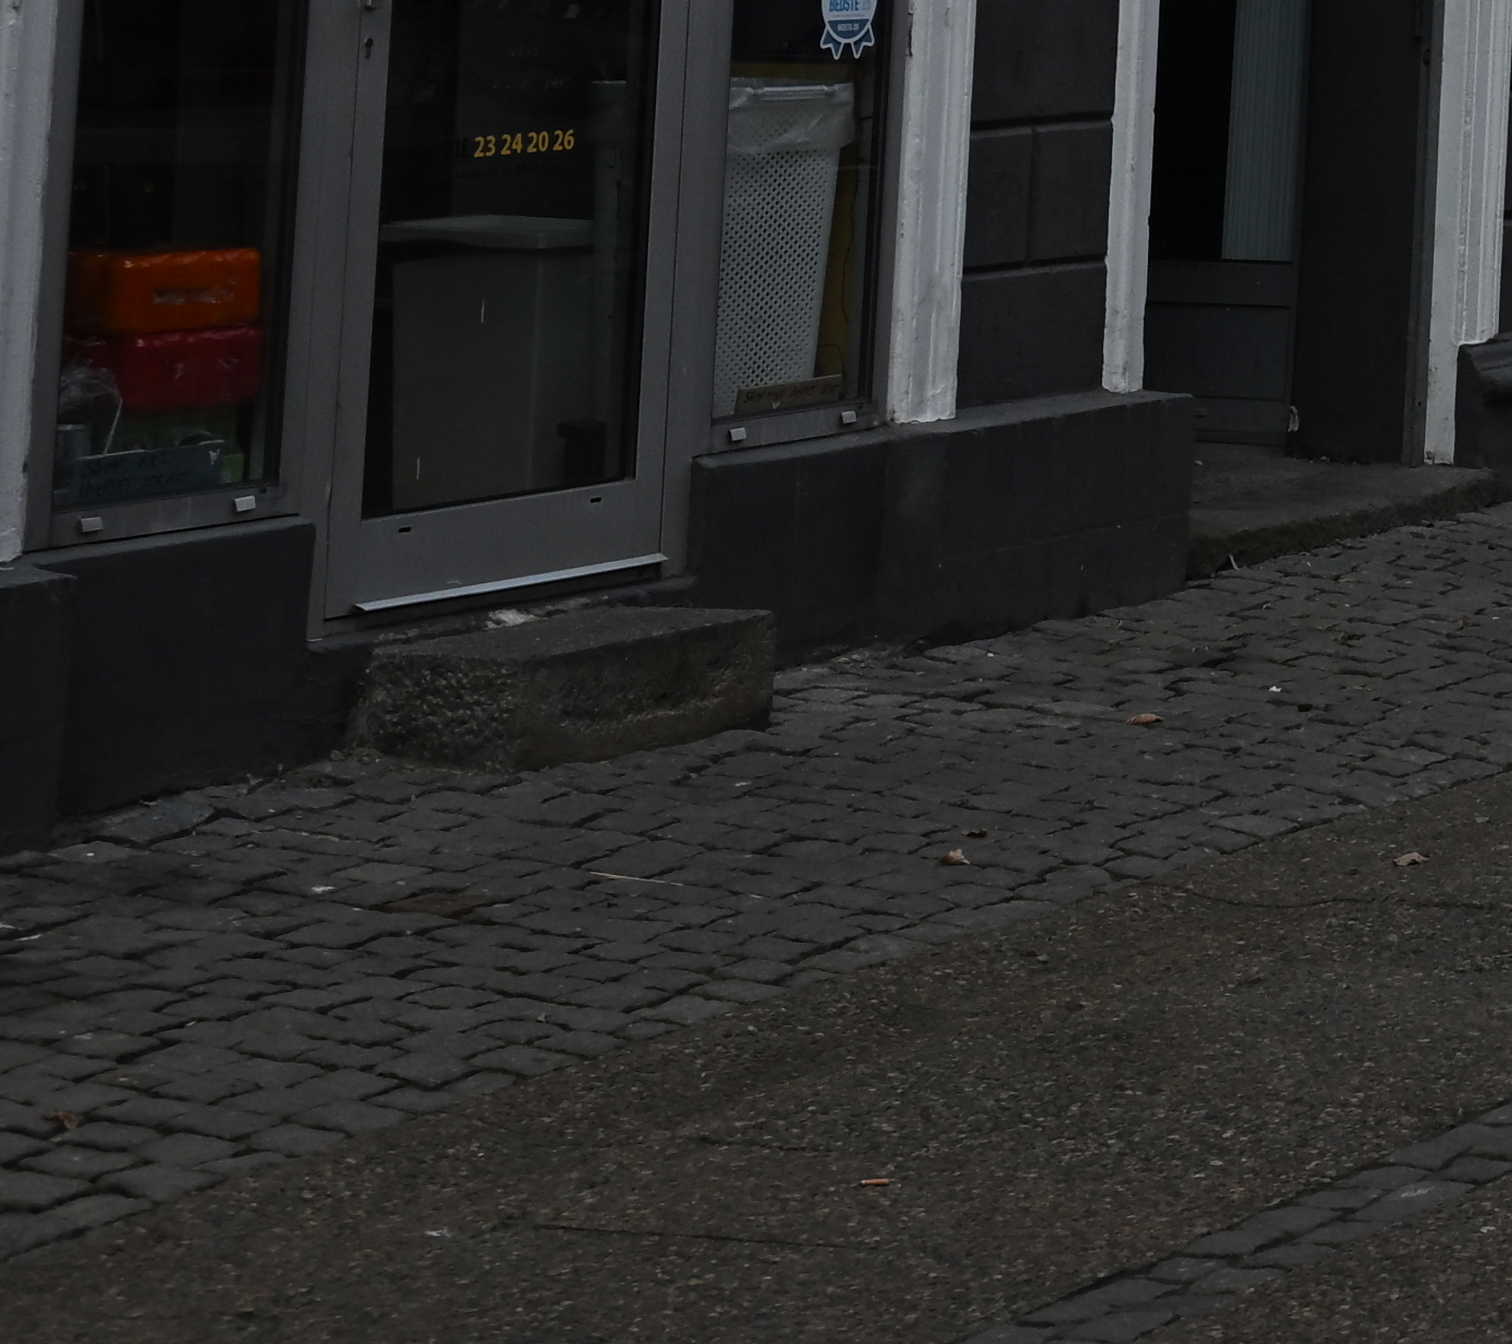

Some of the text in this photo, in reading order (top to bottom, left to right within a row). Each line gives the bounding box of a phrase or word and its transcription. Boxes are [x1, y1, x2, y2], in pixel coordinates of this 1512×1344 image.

[472, 135, 497, 158] 23
[500, 132, 522, 156] 24
[526, 130, 549, 153] 20
[553, 128, 576, 151] 26
